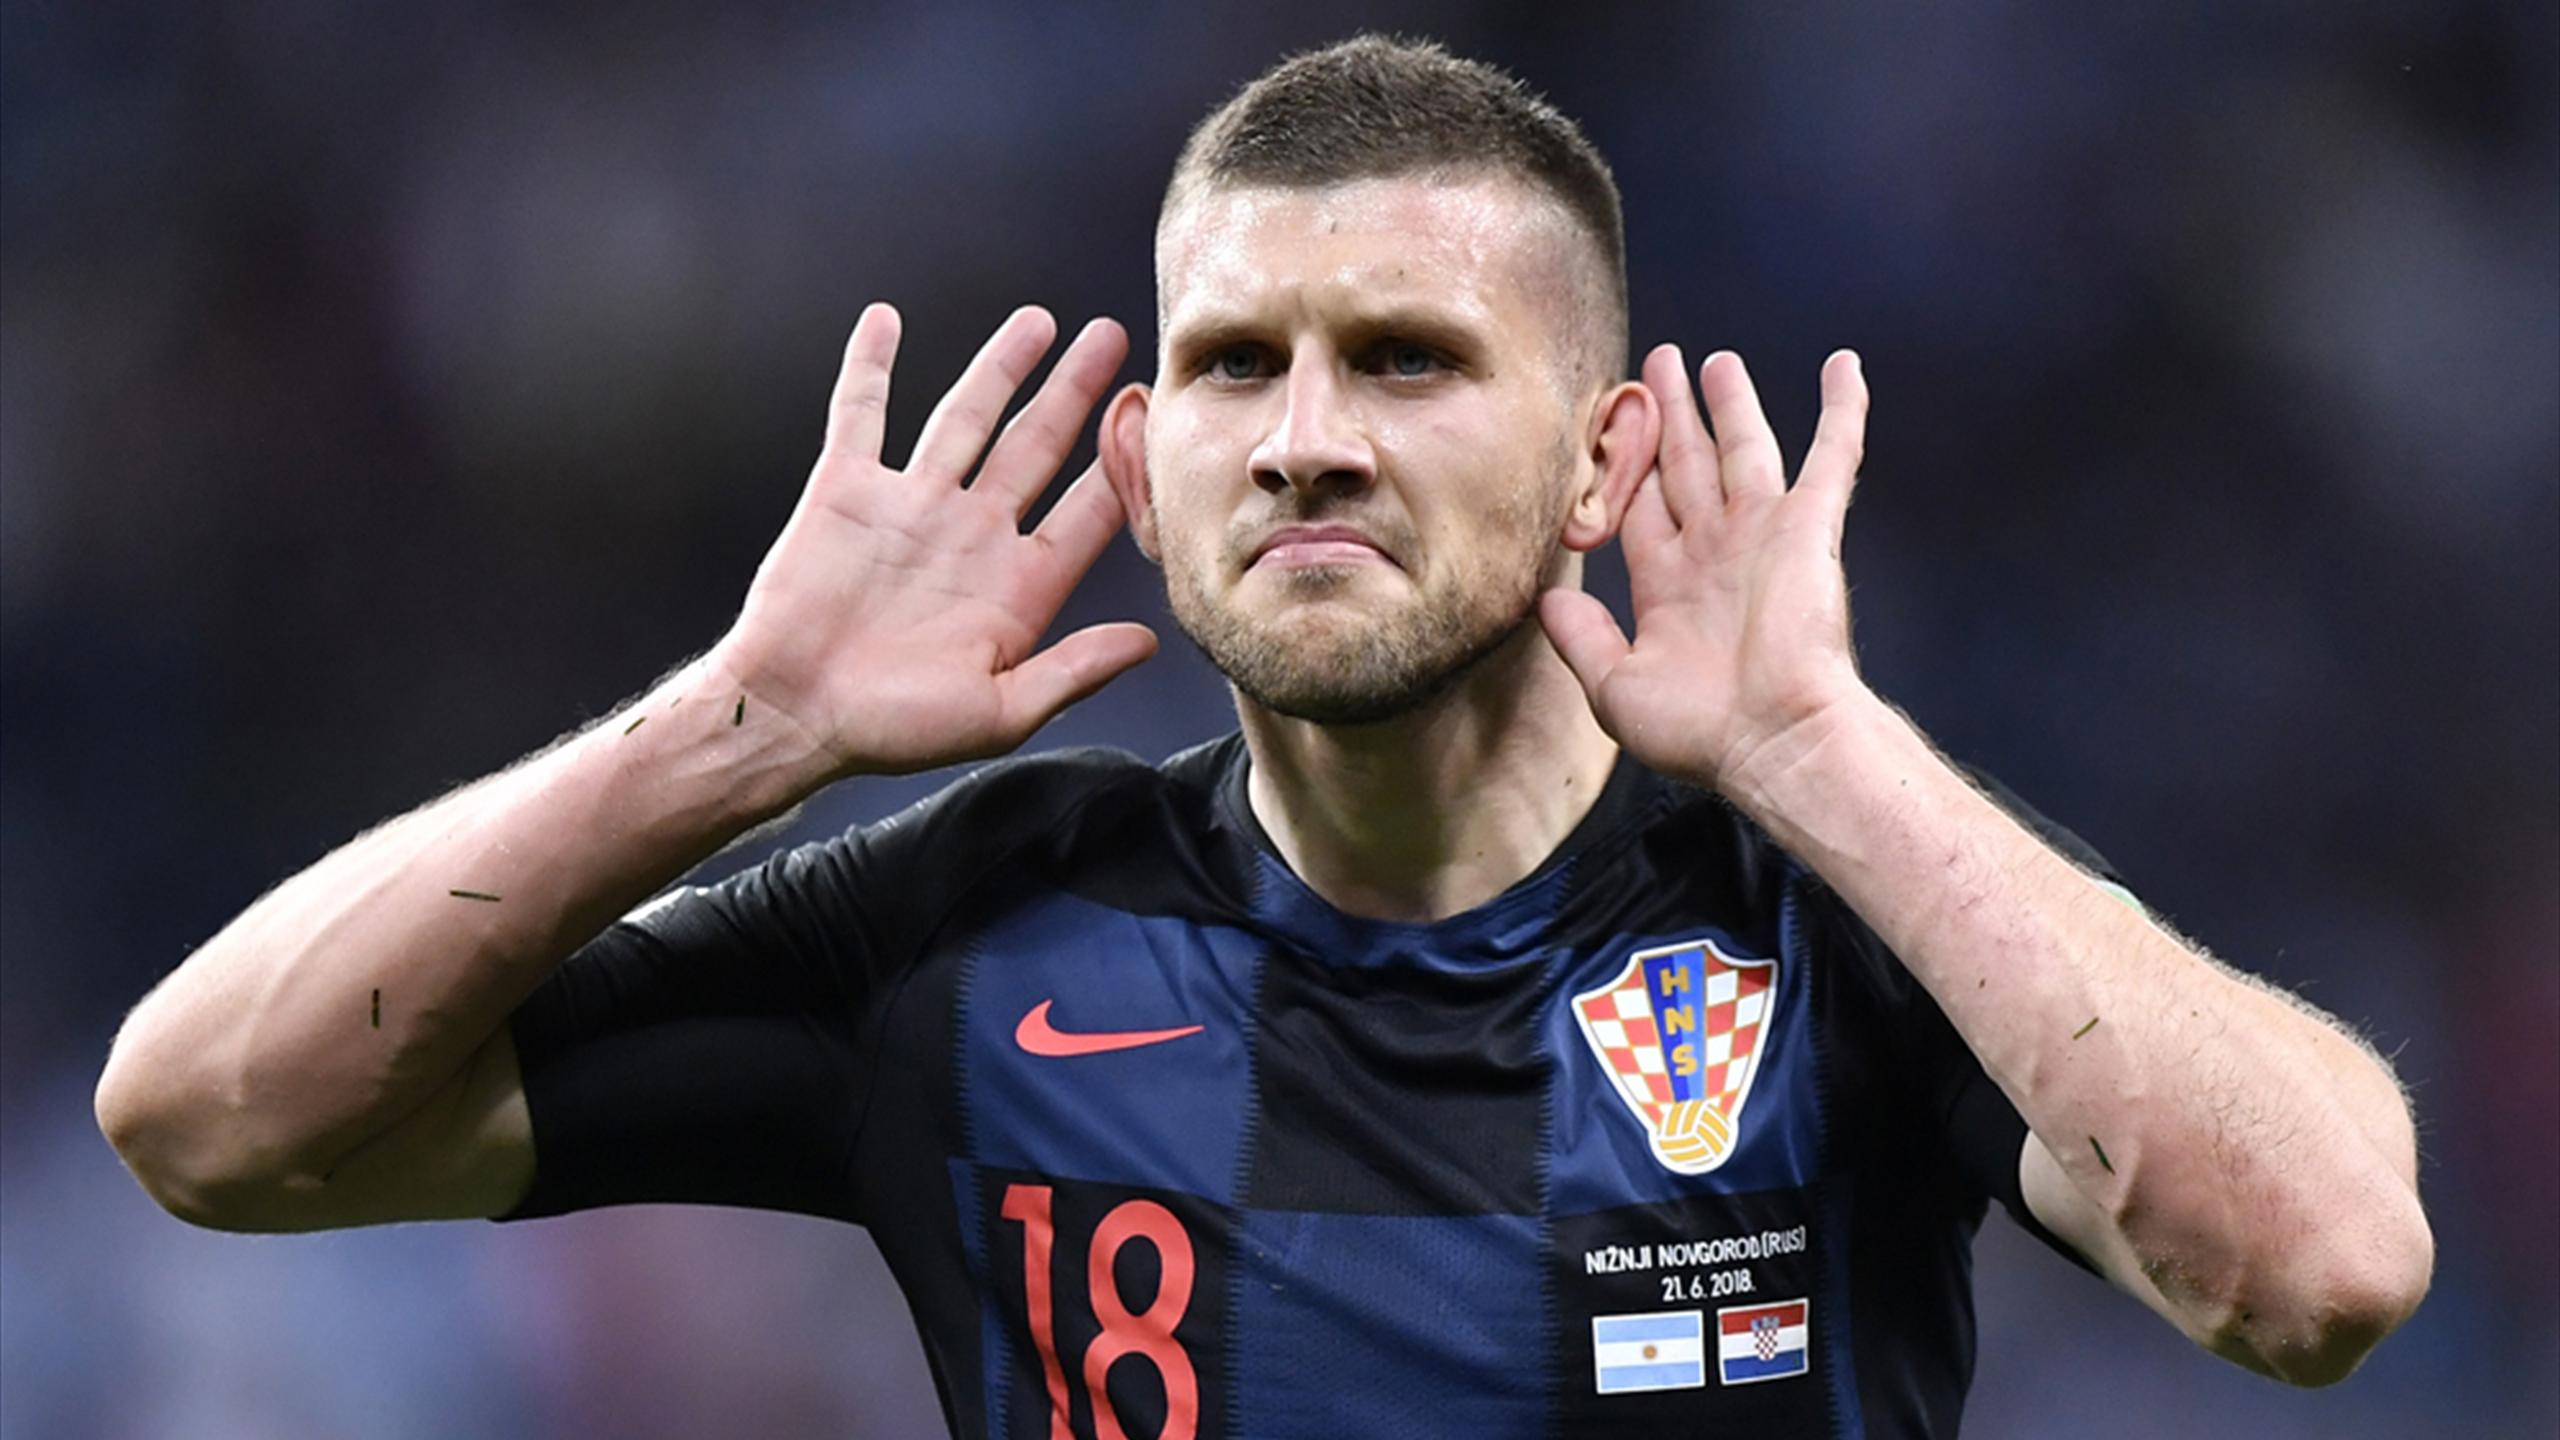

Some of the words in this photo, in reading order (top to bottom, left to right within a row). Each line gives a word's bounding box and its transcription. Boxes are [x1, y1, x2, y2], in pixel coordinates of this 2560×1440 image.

[1659, 965, 1698, 1076] HNS
[1001, 1183, 1199, 1440] 18
[1585, 1245, 1652, 1275] NIŽNJI
